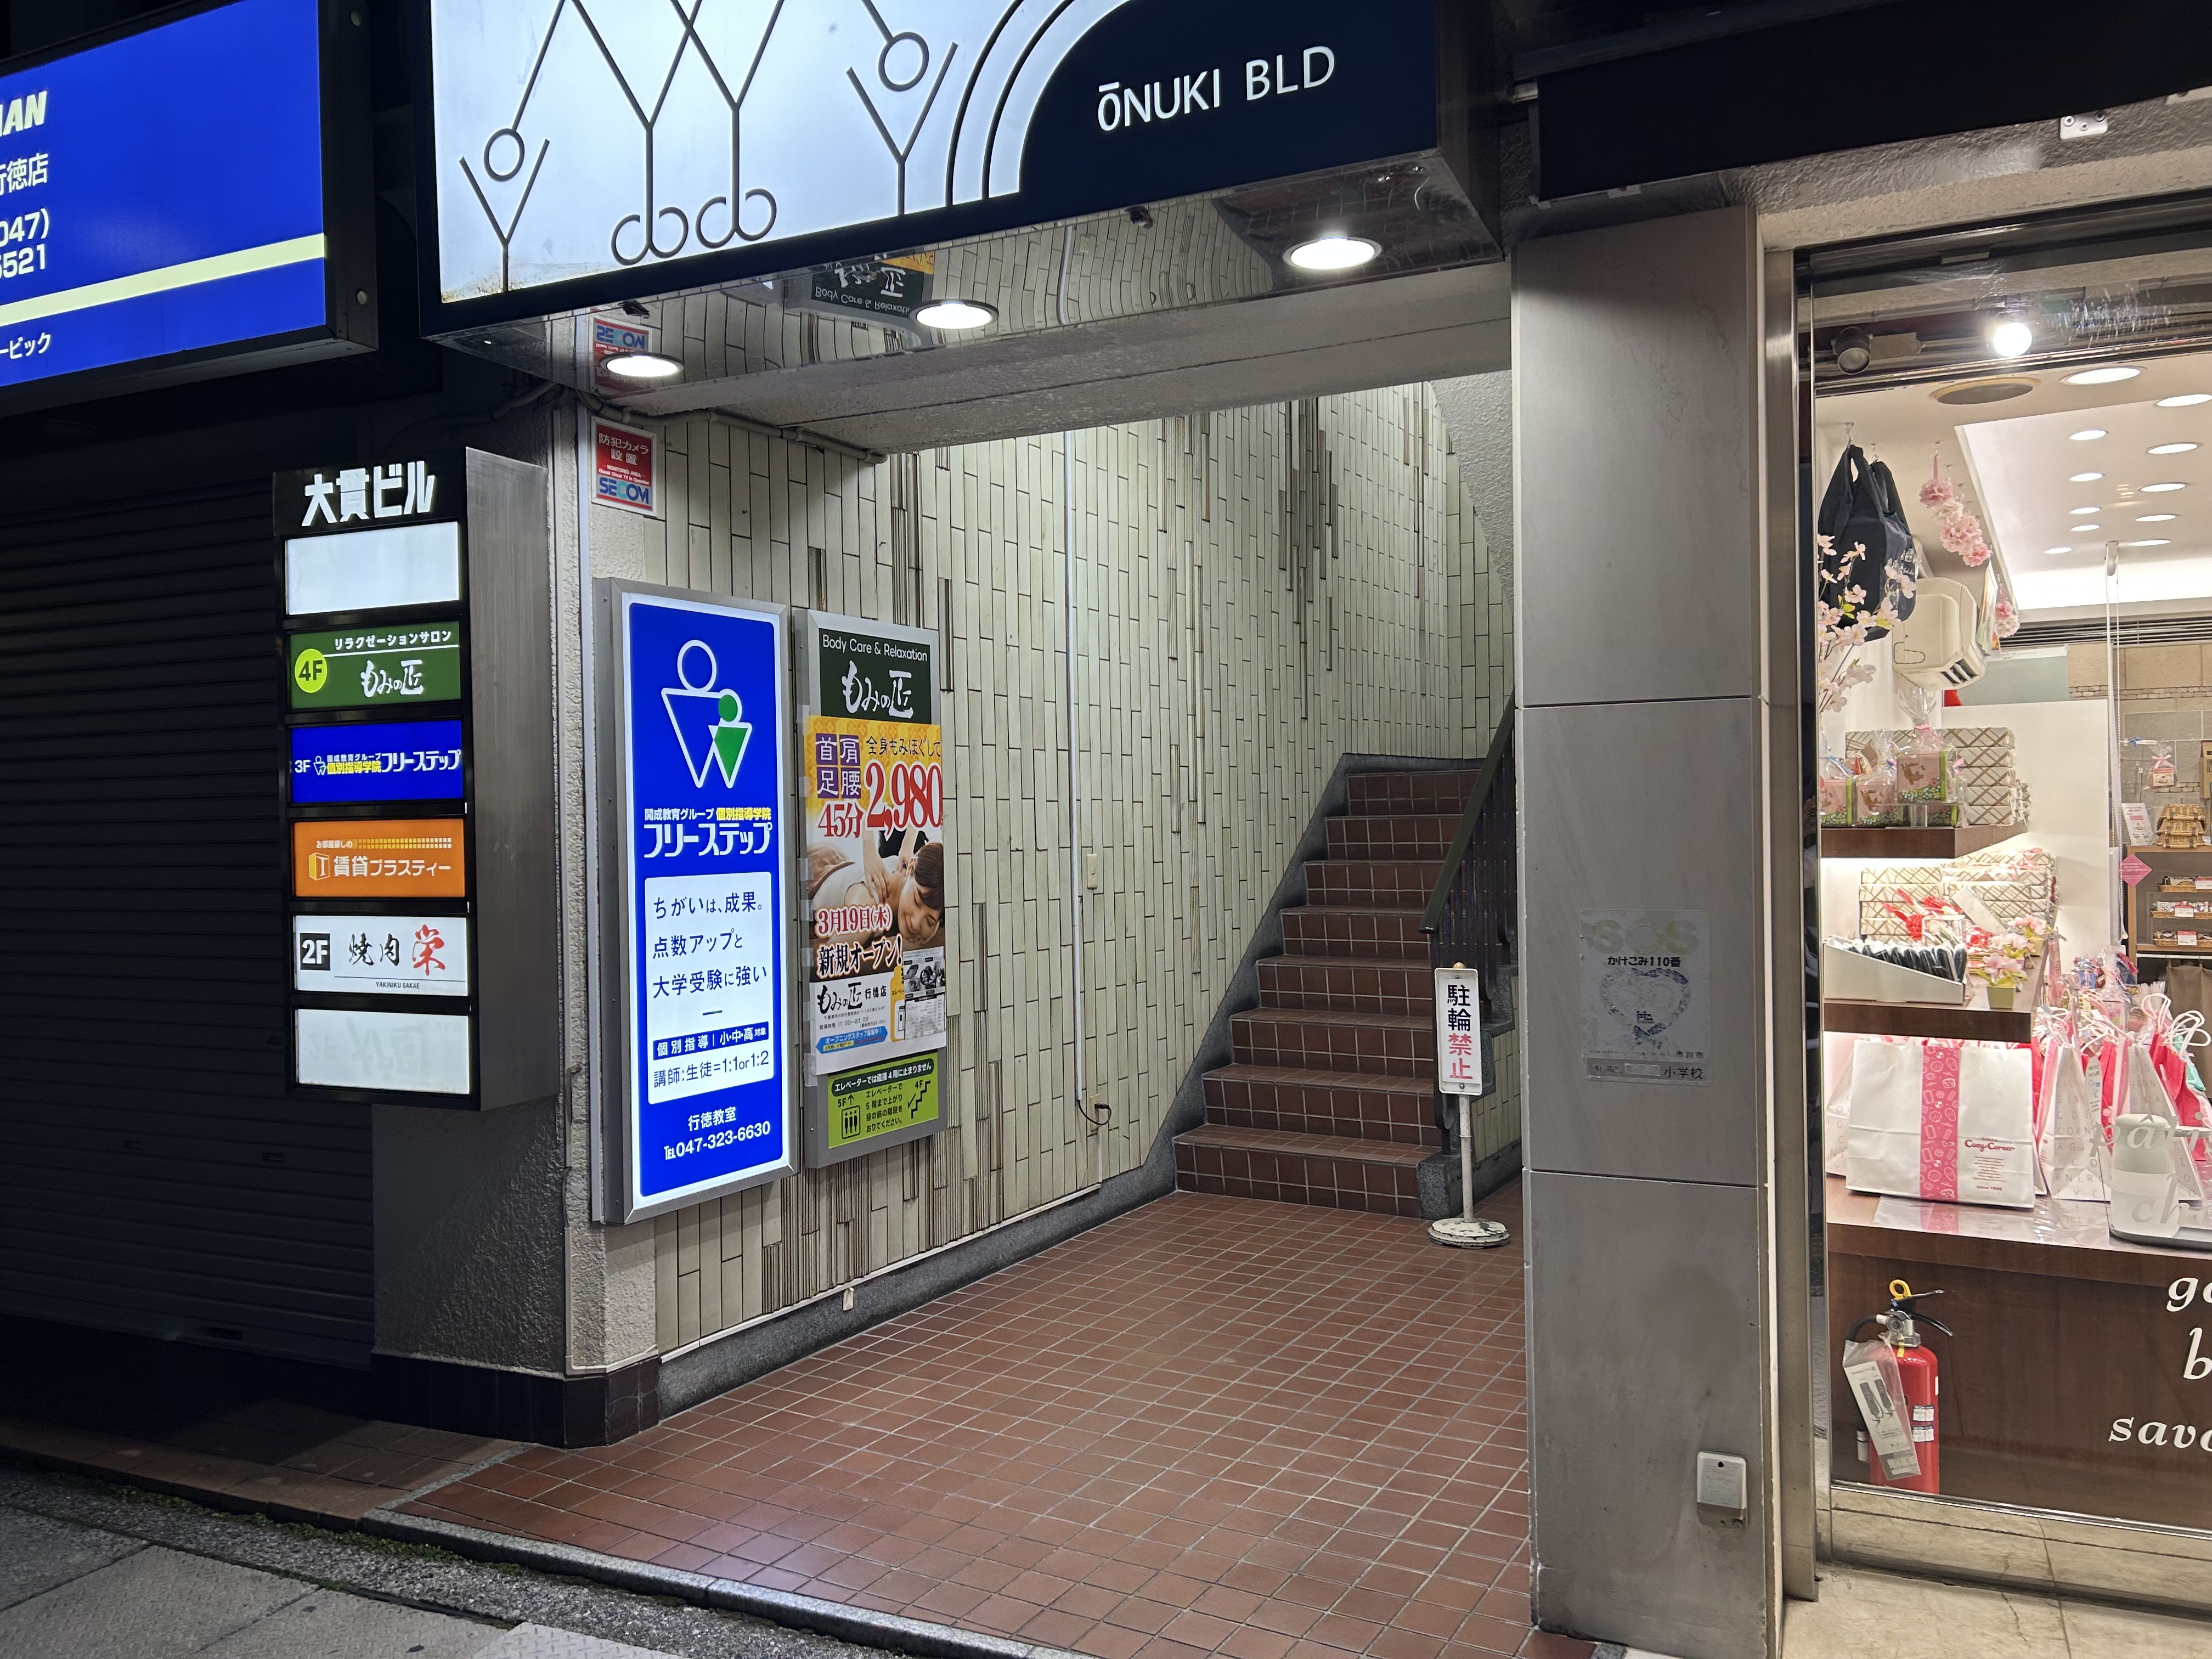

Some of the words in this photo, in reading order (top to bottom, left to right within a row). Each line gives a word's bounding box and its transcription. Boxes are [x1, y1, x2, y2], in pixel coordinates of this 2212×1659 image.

[1245, 46, 1335, 101] BLD
[0, 91, 47, 137] AN
[0, 244, 45, 279] 521
[599, 433, 649, 455] 防犯カメラ
[611, 448, 637, 465] 設置
[301, 460, 435, 527] 大貫ビル
[599, 477, 649, 504] SECOM
[335, 630, 452, 651] リラクゼーションサロン
[822, 634, 847, 653] Body
[850, 639, 872, 654] Care
[874, 641, 881, 655] &
[884, 643, 928, 662] Relaxation
[298, 660, 323, 681] 4F
[866, 735, 941, 758] 全身もみほぐして
[295, 760, 311, 773] 3F
[382, 749, 462, 772] フリーステップ
[865, 762, 943, 836] 2,980
[644, 808, 714, 821] 開成教育グループ
[716, 806, 772, 821] 個別指導学院
[817, 802, 864, 838] 45分
[644, 822, 772, 858] フリーステップ
[334, 855, 452, 877] 賃貸プラスティー
[653, 891, 762, 919] ちがいは、成果。
[818, 906, 891, 934] 3月19日(木)
[302, 939, 328, 964] 2F
[349, 932, 400, 966] 焼肉
[652, 928, 743, 959] 点数アップと
[819, 935, 902, 976] 新規オープン!
[1607, 956, 1681, 967] かけこみ110番
[653, 965, 767, 999] 大学受験に強い
[1447, 984, 1472, 1080] 駐輪禁止
[915, 1080, 923, 1090] 4F
[1663, 1067, 1703, 1080] 小学校
[837, 1097, 847, 1108] 5F
[865, 1082, 903, 1098] エレベーターで
[688, 1106, 737, 1132] 行徳教室
[866, 1105, 903, 1122] 目の前の階段を
